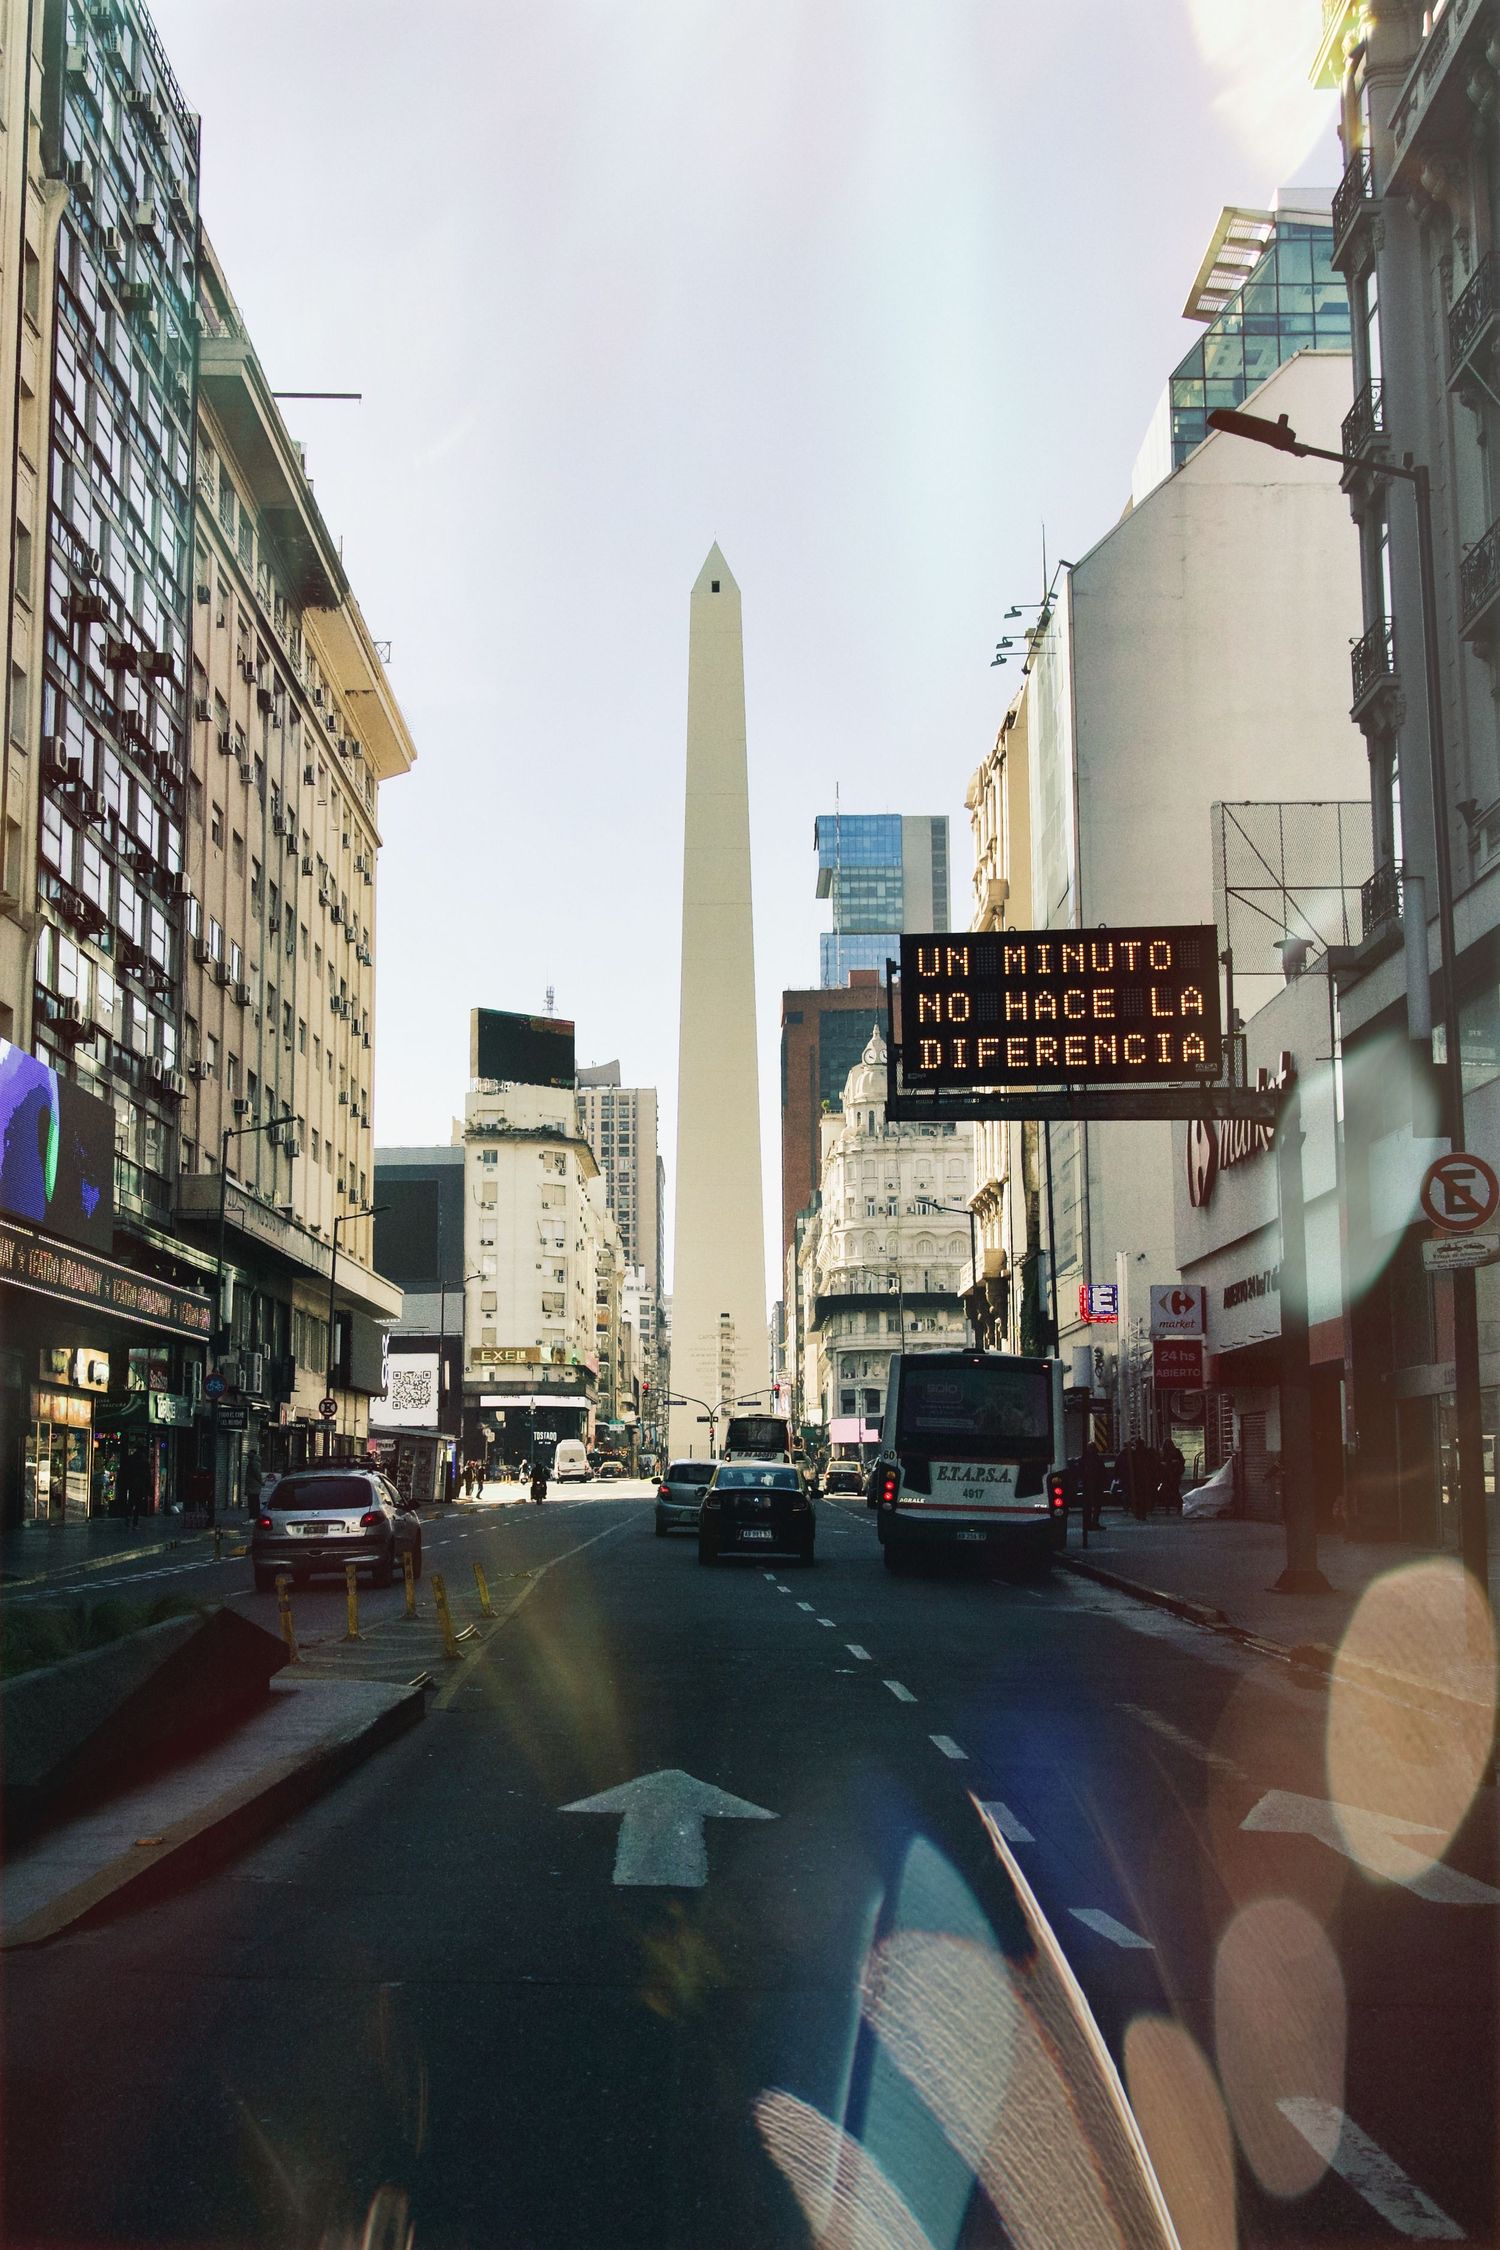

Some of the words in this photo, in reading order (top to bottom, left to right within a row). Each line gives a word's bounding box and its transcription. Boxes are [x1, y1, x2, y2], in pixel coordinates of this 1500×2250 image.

[918, 947, 969, 977] UN
[1004, 941, 1172, 975] MINUTO
[919, 992, 970, 1023] NO
[1005, 989, 1115, 1021] HACE
[1151, 986, 1203, 1016] LA
[919, 1033, 1205, 1069] DIFERENCIA
[1159, 1319, 1196, 1329] market
[1161, 1350, 1178, 1361] 24
[1180, 1350, 1196, 1361] hs
[1155, 1367, 1201, 1378] ABIERTO
[533, 1431, 557, 1442] TOSTADO
[883, 1450, 895, 1459] 60
[963, 1489, 984, 1499] 4917
